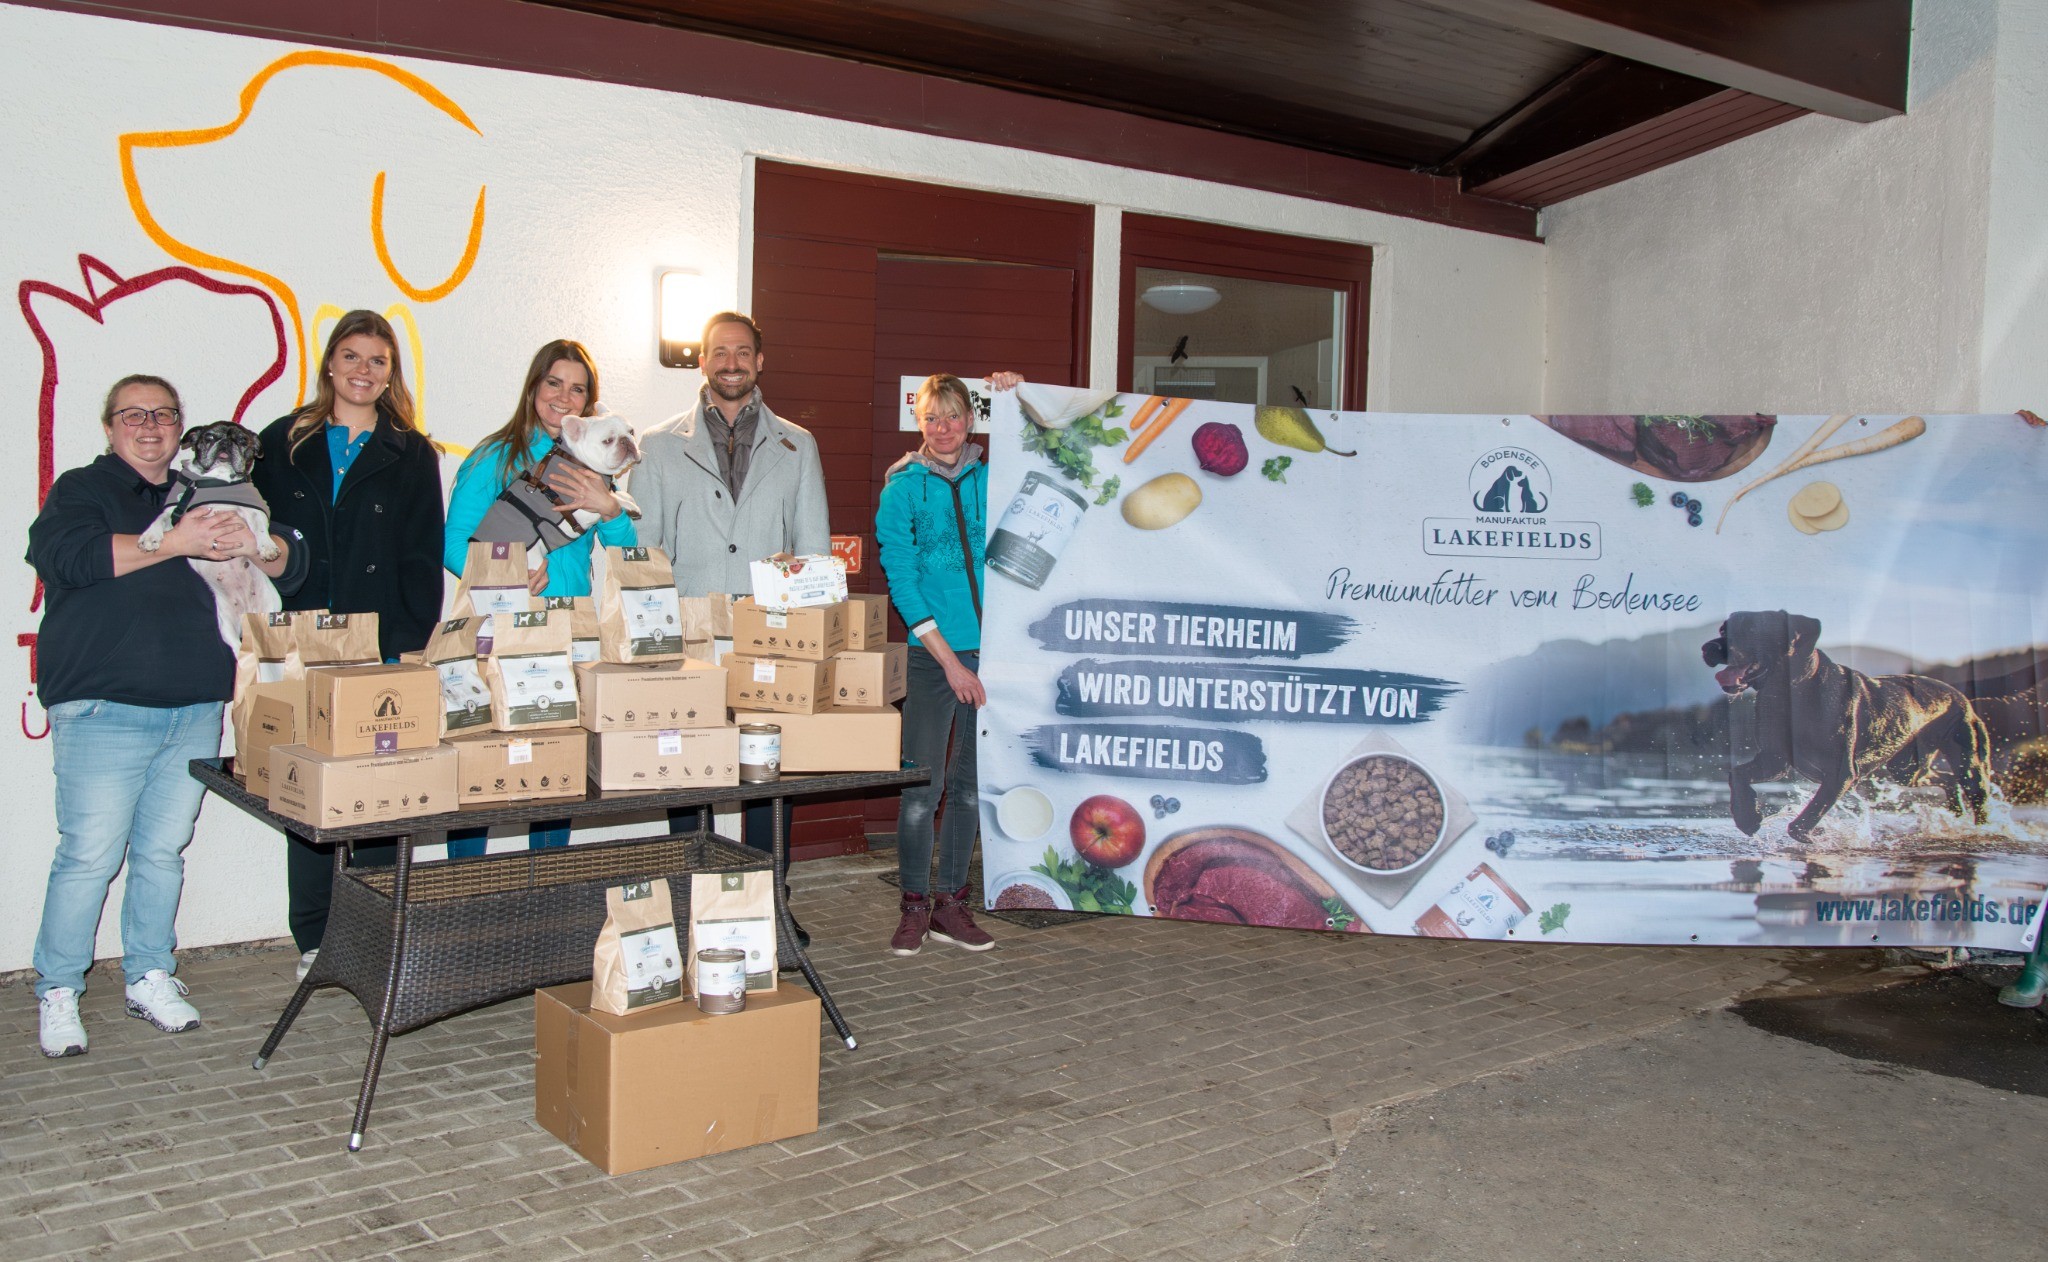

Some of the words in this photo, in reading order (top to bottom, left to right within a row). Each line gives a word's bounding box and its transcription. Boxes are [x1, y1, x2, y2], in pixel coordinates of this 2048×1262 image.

[1480, 450, 1540, 470] BODENSEE
[1476, 516, 1547, 526] MANUFAKTUR
[831, 541, 846, 551] ITT
[1432, 528, 1593, 550] LAKEFIELDS
[1325, 567, 1499, 608] Premiumfutter
[1510, 590, 1558, 609] vom
[1572, 572, 1702, 615] Bodensee
[1064, 609, 1156, 644] UNSER
[1163, 613, 1297, 651] TIERHEIM
[1077, 672, 1150, 706] WIRD
[1158, 675, 1356, 716] UNTERSTÜTZT
[1362, 686, 1418, 719] VON
[360, 721, 416, 733] LAKEFIELDS
[1059, 732, 1224, 772] LAKEFIELDS
[1816, 893, 2039, 926] www.lakefields.de
